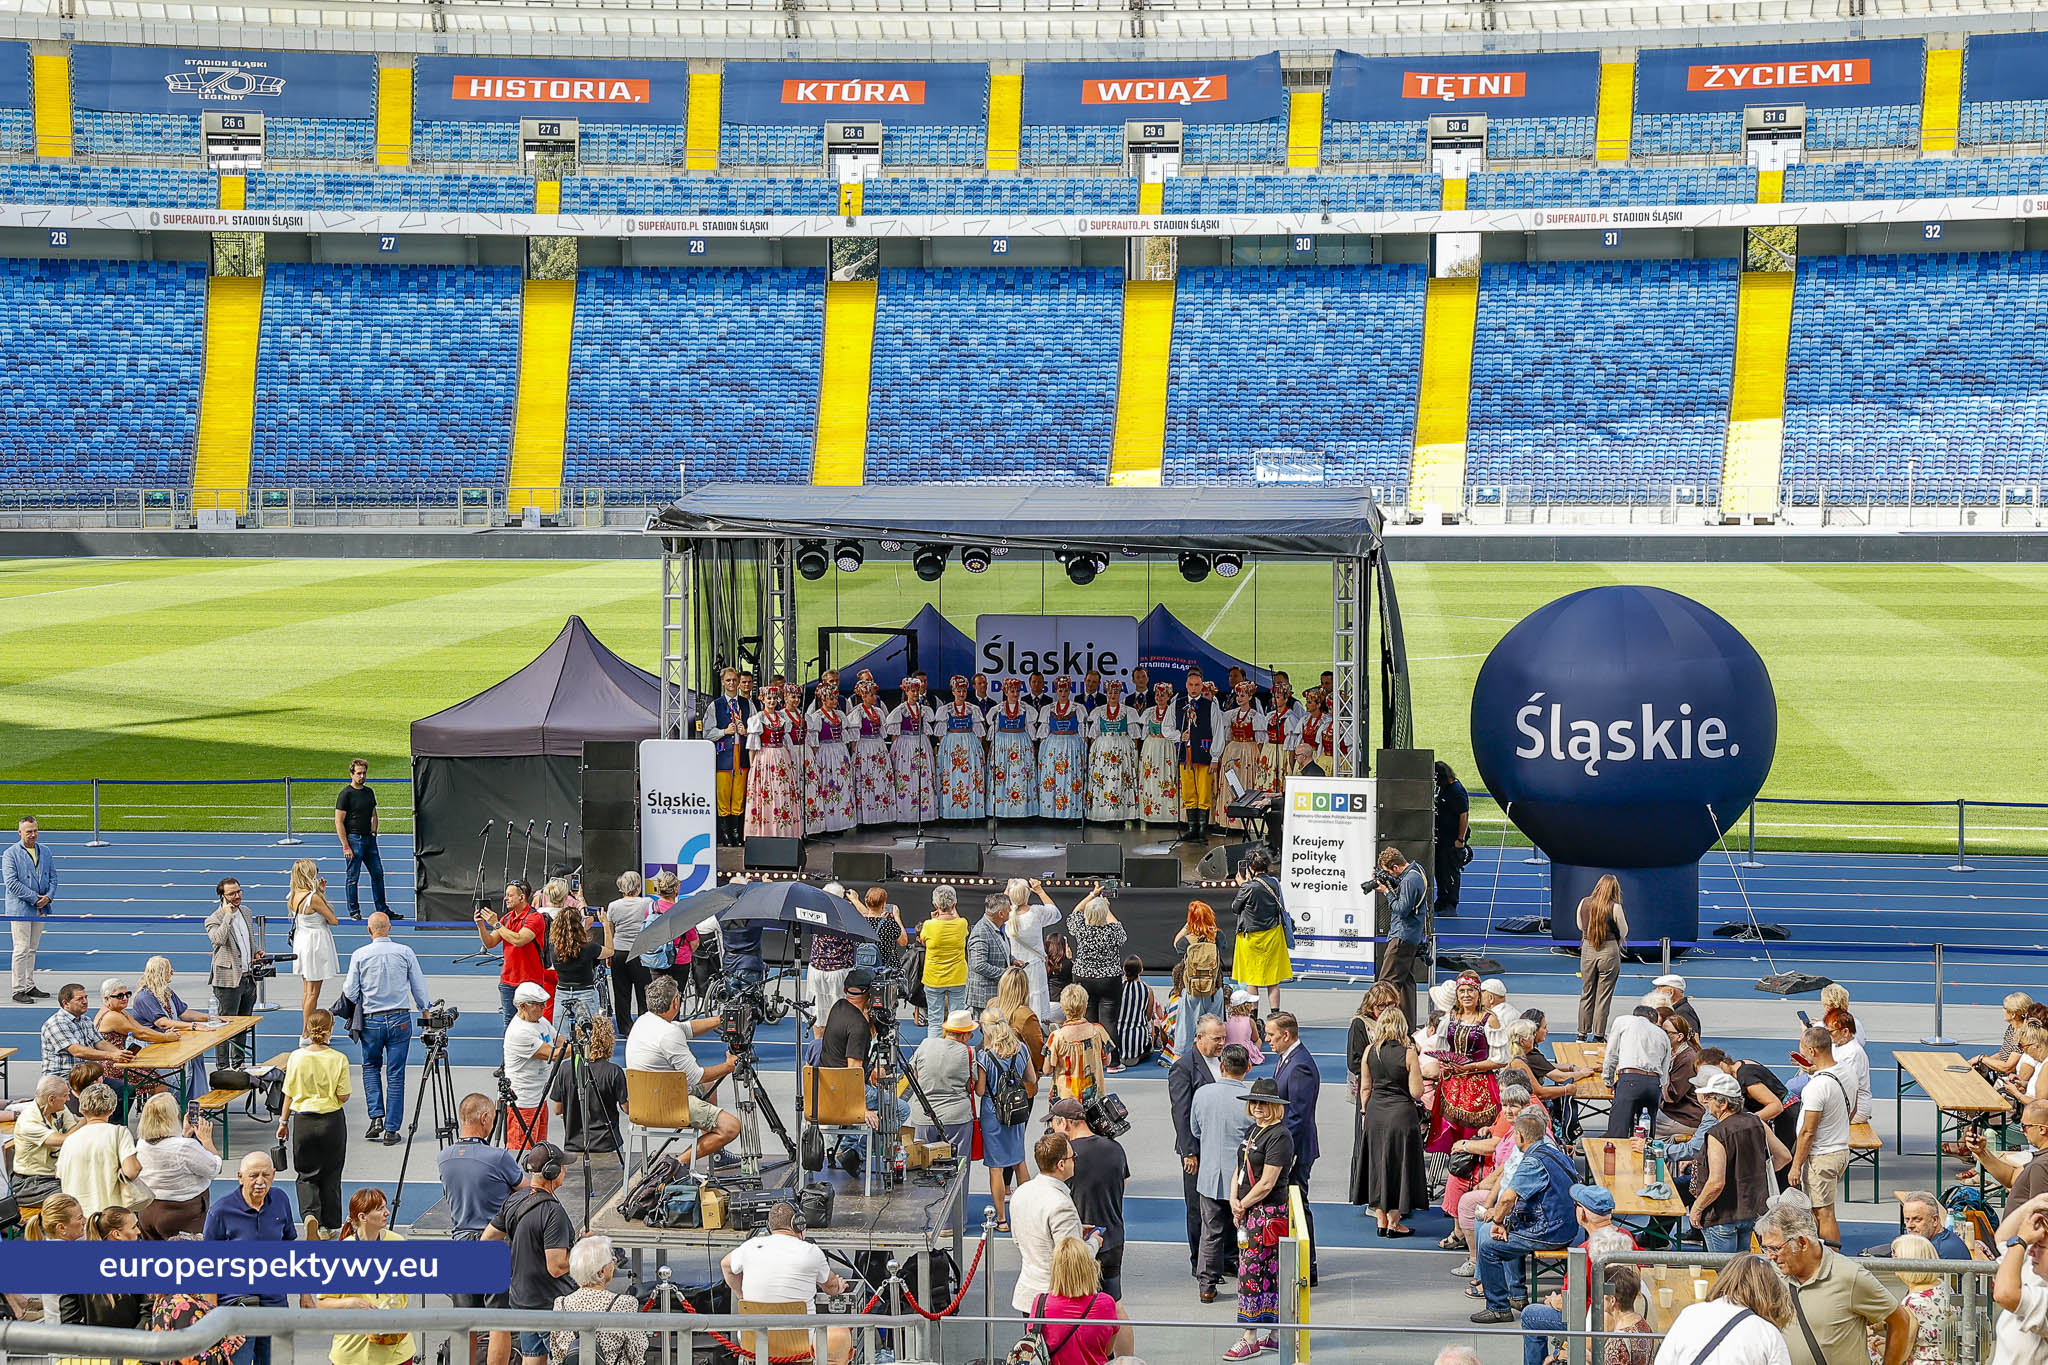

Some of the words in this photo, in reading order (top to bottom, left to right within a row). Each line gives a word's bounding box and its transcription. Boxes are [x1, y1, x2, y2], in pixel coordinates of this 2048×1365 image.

[184, 59, 229, 67] STADION
[231, 59, 268, 69] ŚLĄSKI
[1703, 63, 1854, 88] ŻYCIEM!
[469, 78, 641, 103] HISTORIA,
[796, 78, 911, 102] KTÓRA
[1097, 77, 1212, 106] WCIĄŻ
[1415, 75, 1512, 102] TĘTNI
[223, 117, 235, 128] 26
[237, 119, 244, 128] G
[1765, 111, 1776, 121] 31
[1778, 113, 1785, 121] G
[540, 124, 552, 134] 27
[553, 126, 559, 134] G
[844, 127, 856, 137] 28
[857, 129, 863, 137] G
[1145, 126, 1156, 136] 29
[1157, 128, 1163, 136] G
[1448, 121, 1460, 131] 30
[1461, 122, 1467, 131] G
[163, 214, 229, 226] SUPERAUTO.PL
[232, 215, 270, 226] STADION
[272, 214, 303, 230] ŚLĄSKI
[1546, 212, 1610, 224] SUPERAUTO.PL
[1612, 211, 1650, 223] STADION
[1652, 209, 1683, 225] ŚLĄSKI
[638, 220, 700, 231] SUPERAUTO.PL
[702, 221, 738, 231] STADION
[740, 219, 769, 234] ŚLĄSKI
[1090, 220, 1151, 231] SUPERAUTO.PL
[1153, 220, 1189, 230] STADION
[1190, 217, 1220, 233] ŚLĄSKI
[1925, 224, 1941, 239] 32
[51, 231, 67, 245] 26
[381, 237, 395, 250] 27
[1296, 237, 1311, 251] 30
[1604, 232, 1618, 246] 31
[689, 240, 705, 253] 28
[993, 239, 1007, 253] 29
[1171, 662, 1192, 671] ŚLĄS
[990, 680, 1028, 694] DA
[1515, 692, 1740, 777] Śląskie.
[647, 789, 711, 811] Śląskie.
[1297, 795, 1364, 810] ROPS
[1292, 835, 1345, 850] Kreujemy
[1291, 850, 1337, 864] politykę
[1291, 865, 1346, 879] społeczną
[1290, 881, 1301, 889] w
[1303, 880, 1348, 893] regionie
